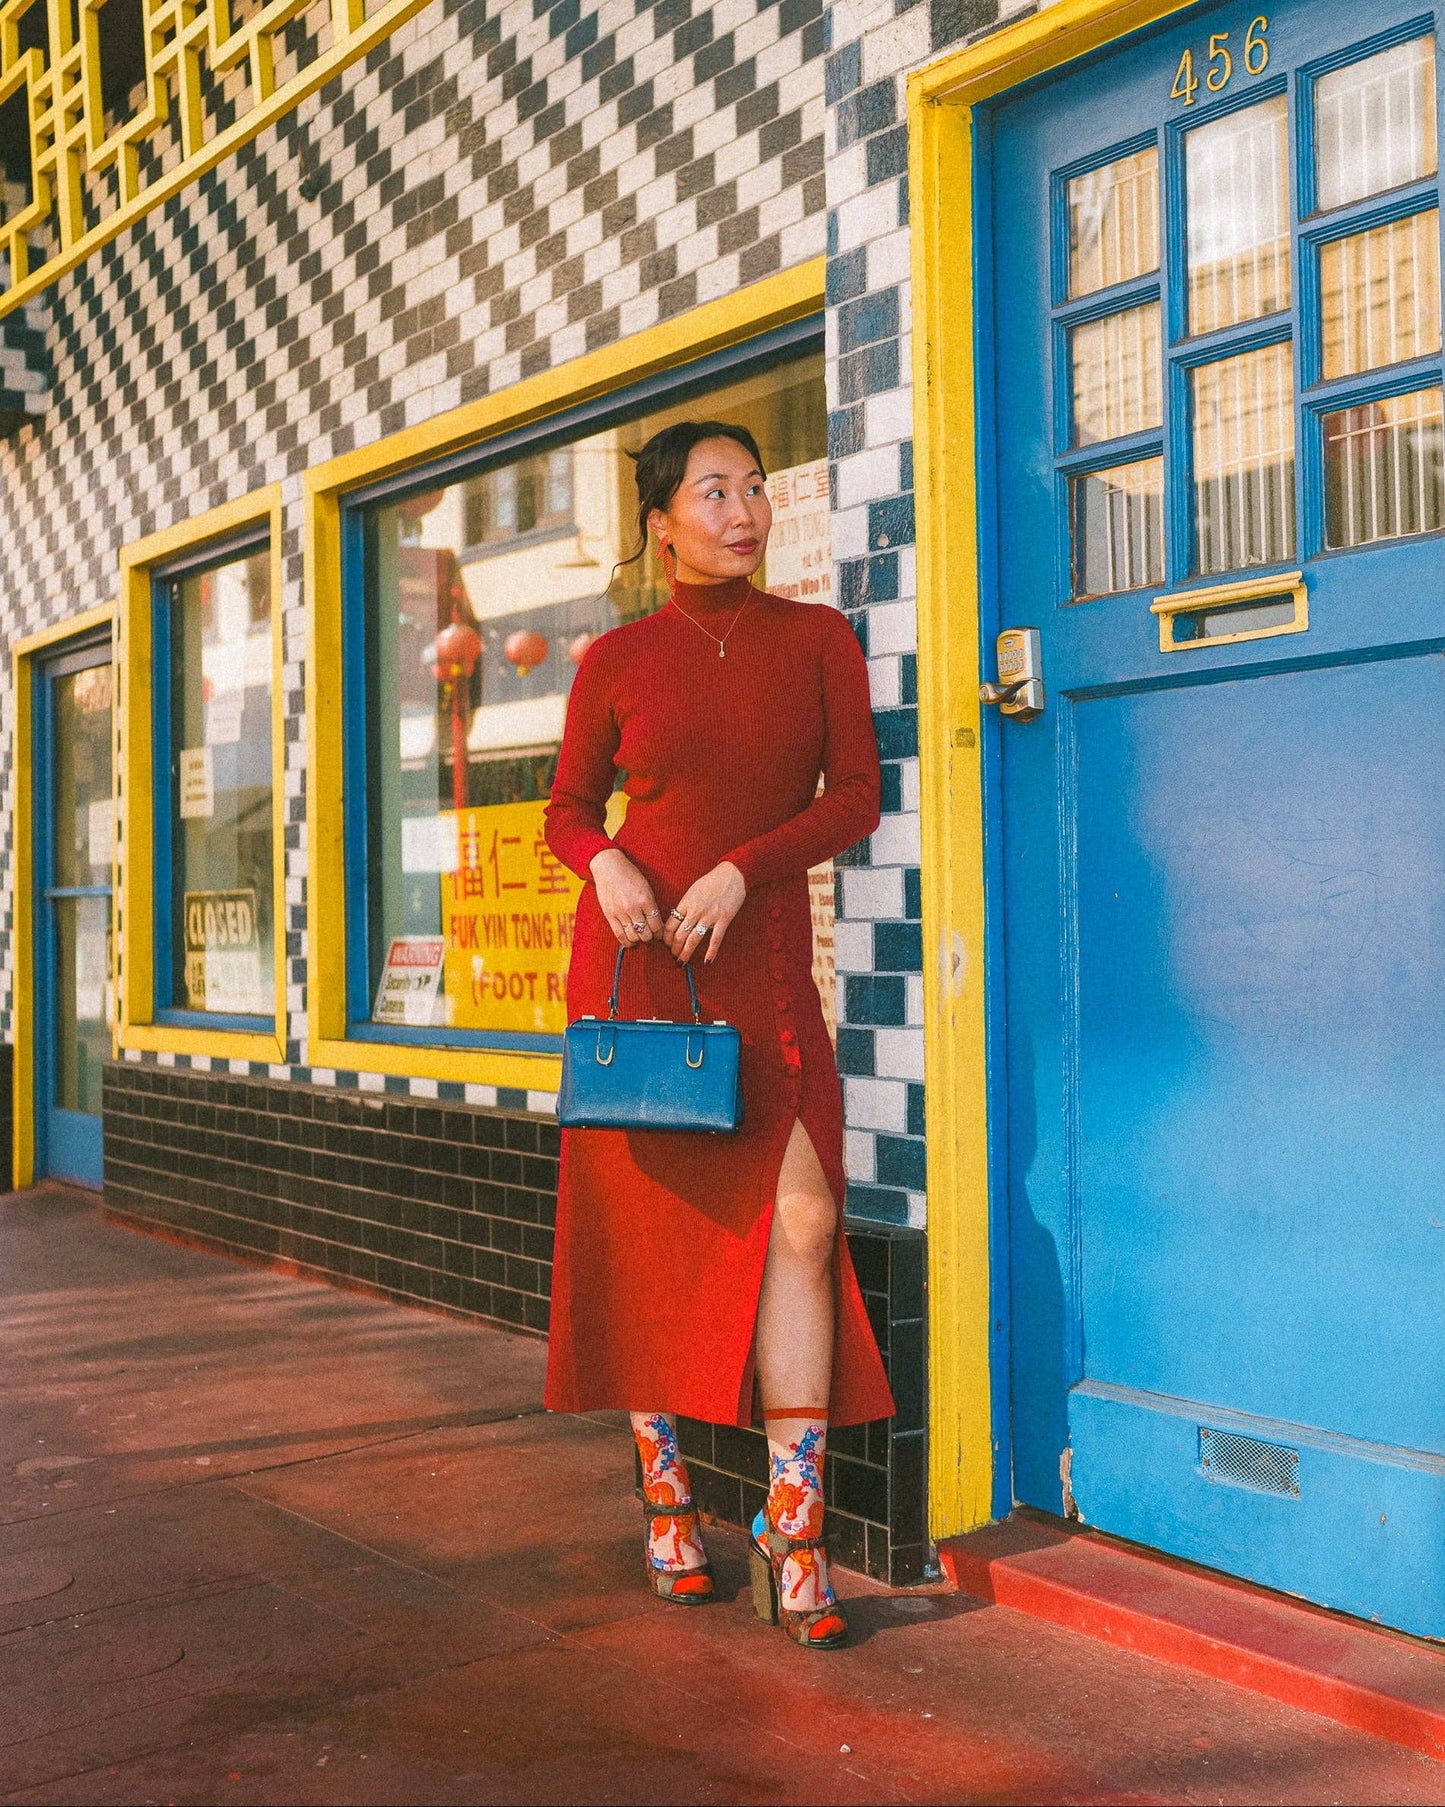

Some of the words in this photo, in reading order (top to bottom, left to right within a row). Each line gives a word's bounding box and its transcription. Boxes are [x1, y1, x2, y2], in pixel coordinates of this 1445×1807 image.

[1170, 15, 1270, 107] 456
[770, 466, 829, 510] 福仁堂
[449, 829, 570, 900] 福仁堂
[188, 900, 252, 947] CLOSED
[451, 915, 479, 949] FUK
[483, 914, 507, 948] YIN
[511, 912, 553, 949] TONG
[471, 972, 537, 1007] (FOOT
